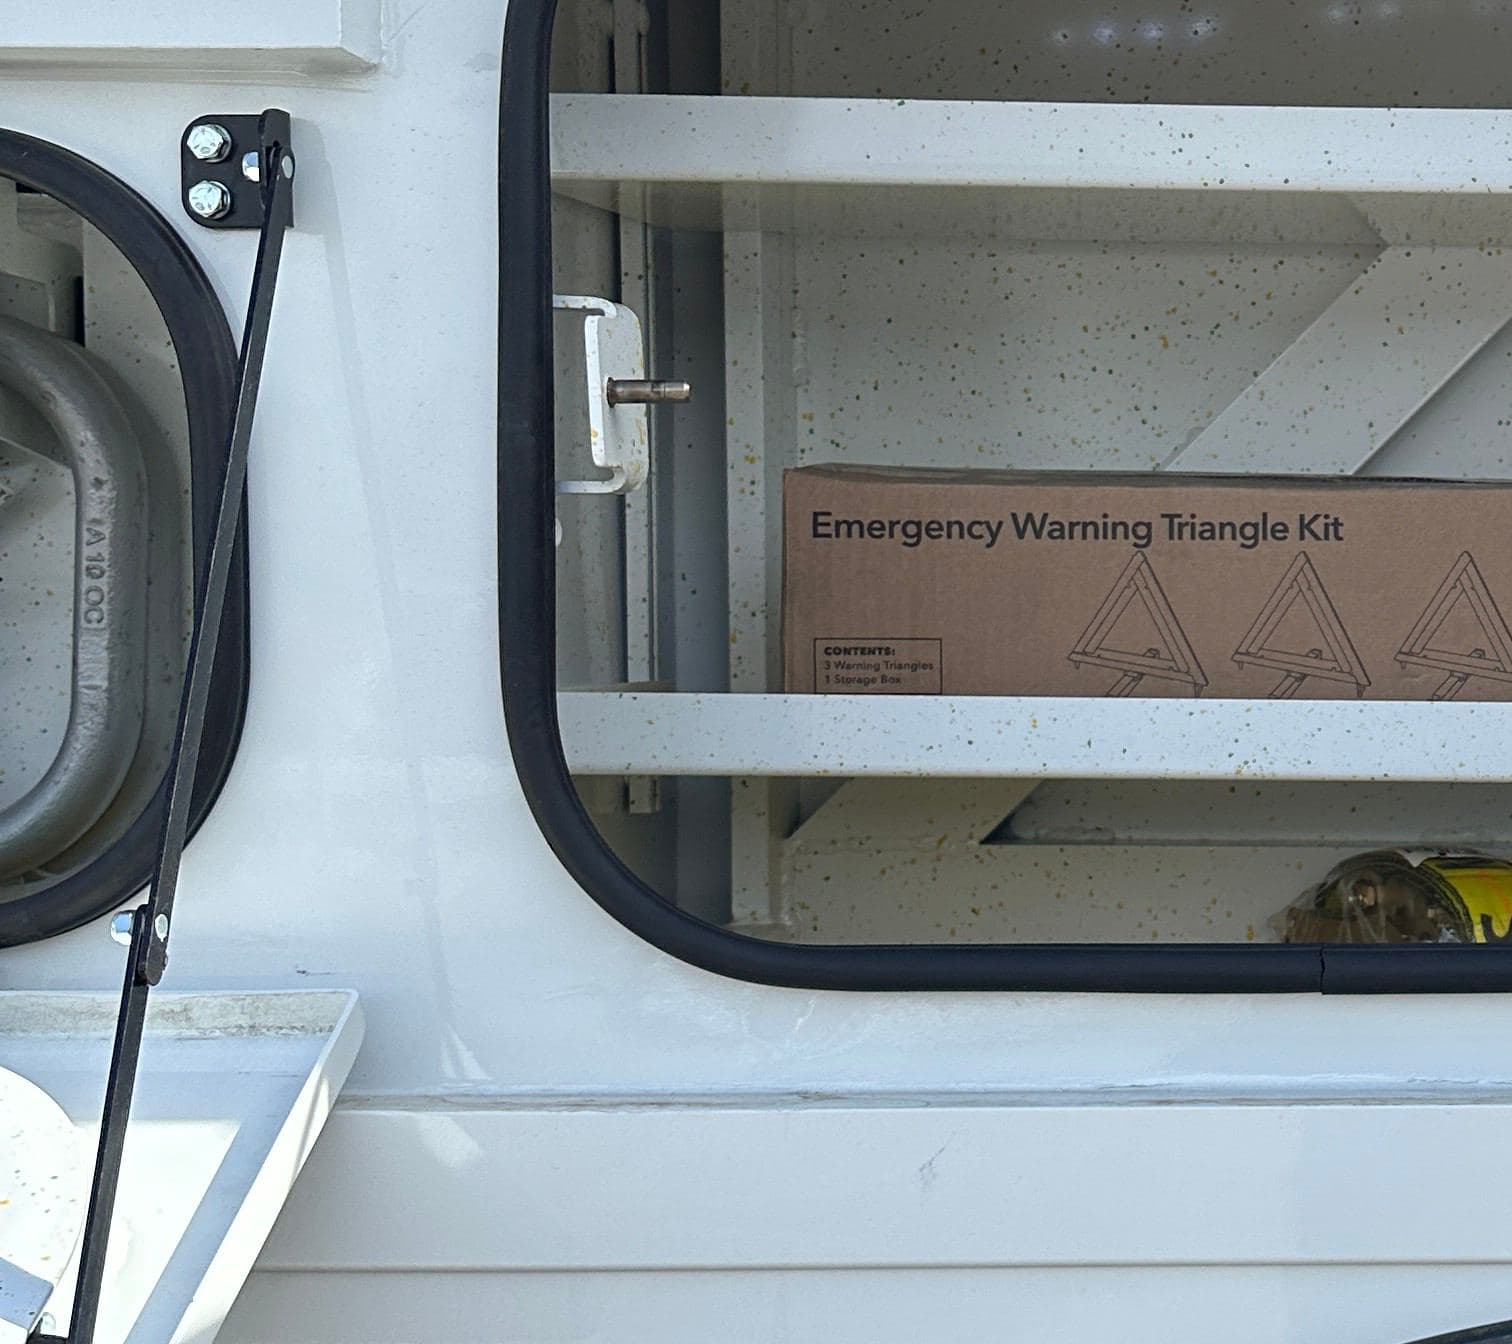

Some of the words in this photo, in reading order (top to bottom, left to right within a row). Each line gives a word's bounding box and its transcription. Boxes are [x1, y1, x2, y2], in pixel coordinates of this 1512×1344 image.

[811, 511, 1003, 548] Emergency
[1010, 512, 1152, 548] Warning
[1160, 512, 1289, 550] Triangle
[1298, 513, 1344, 542] Kit
[824, 646, 896, 656] CONTENTS:
[824, 660, 831, 670] 3
[834, 660, 880, 672] Warning
[884, 660, 934, 672] Triangles
[834, 674, 877, 686] Storage
[881, 674, 901, 684] Box
